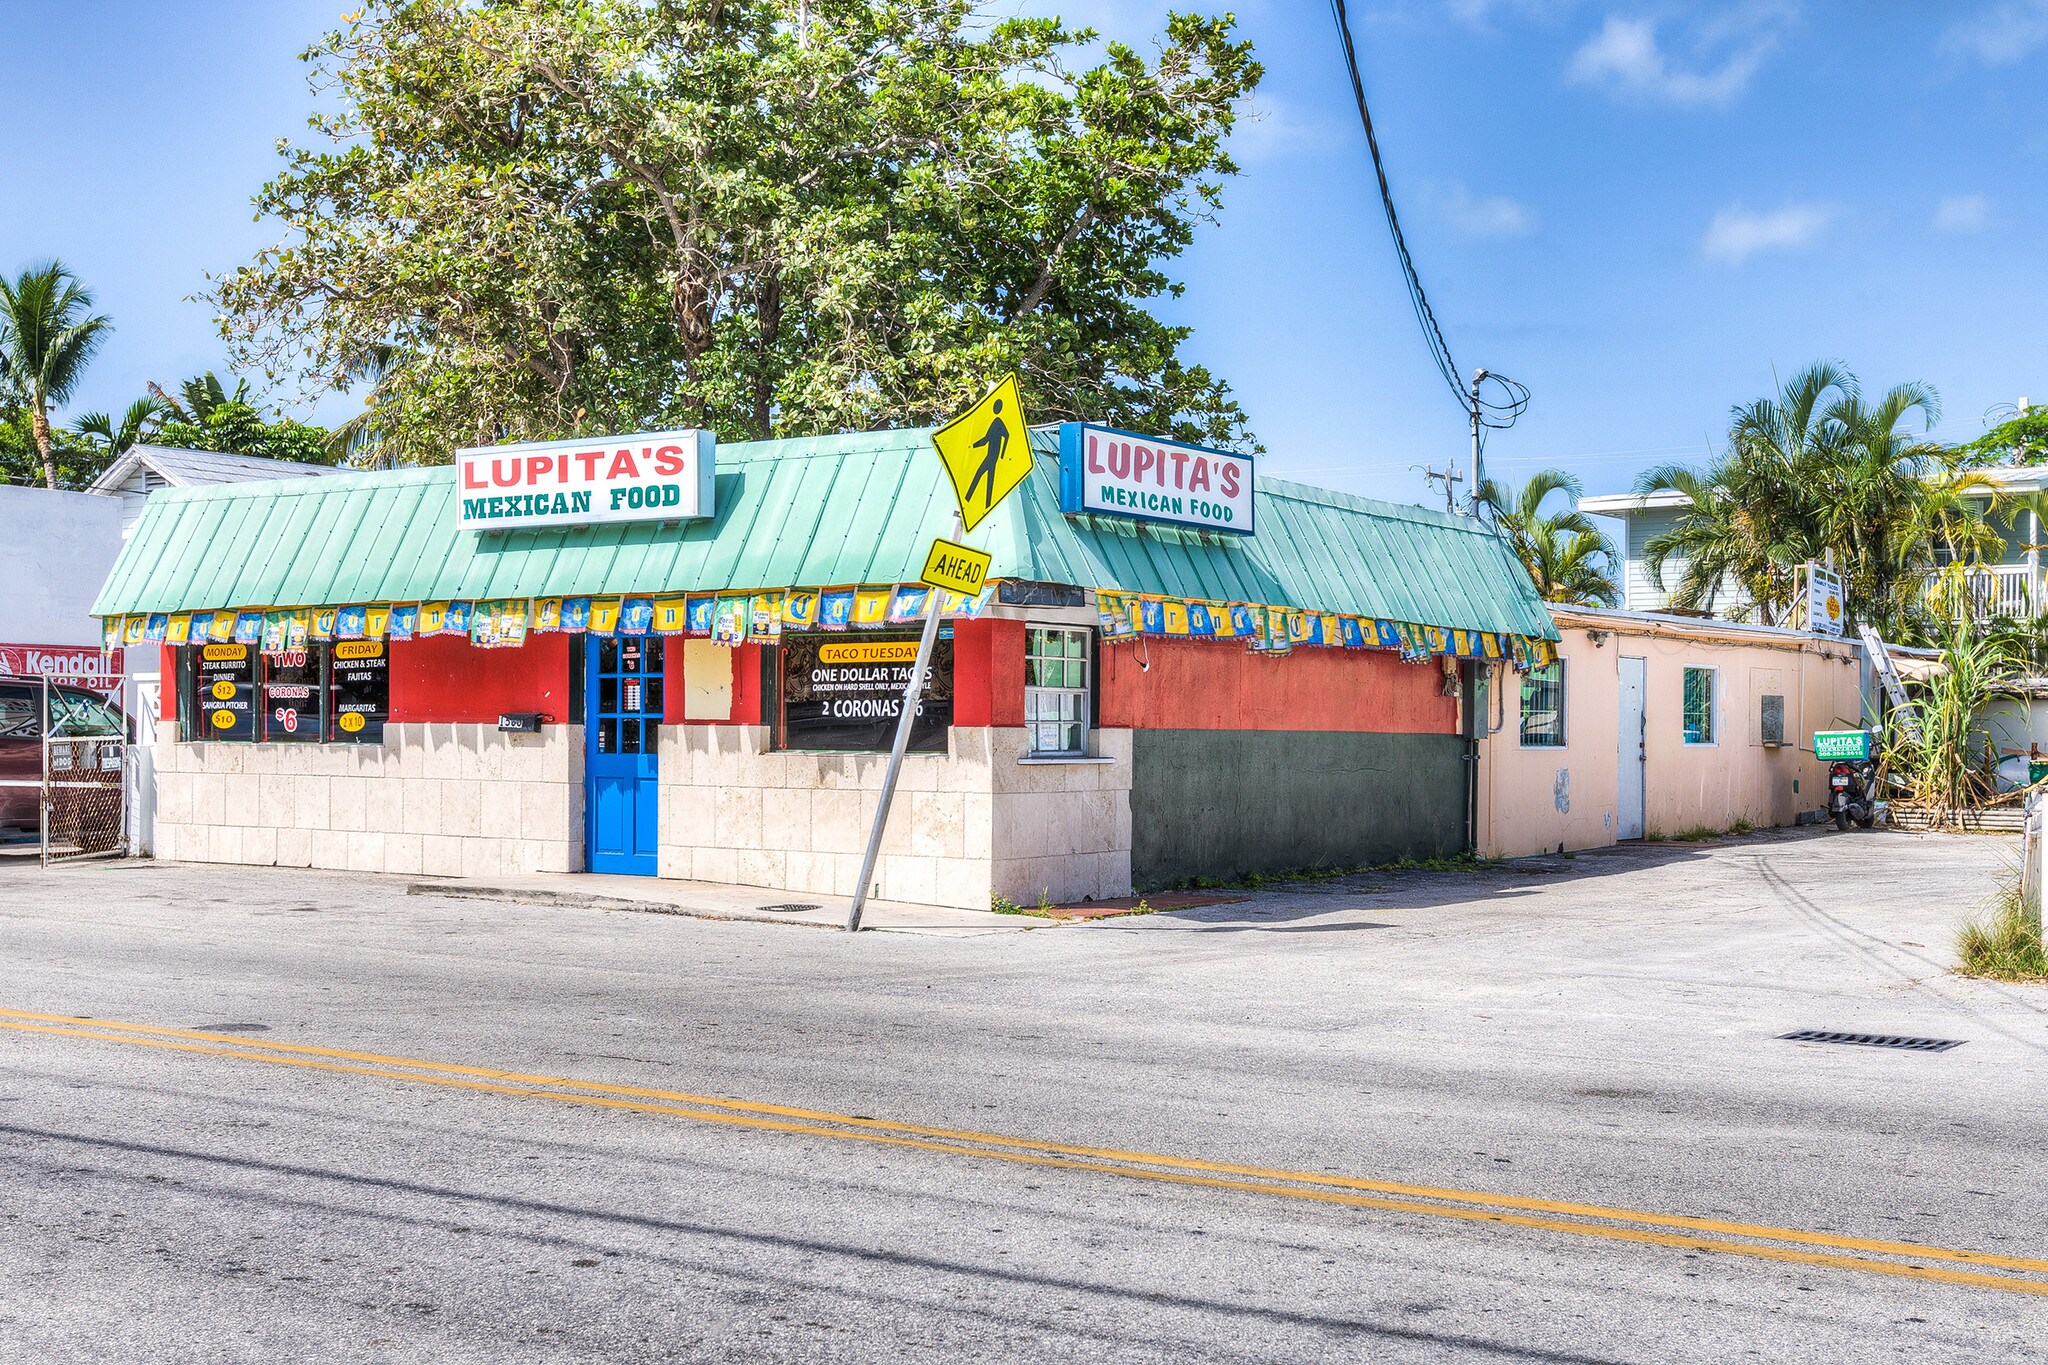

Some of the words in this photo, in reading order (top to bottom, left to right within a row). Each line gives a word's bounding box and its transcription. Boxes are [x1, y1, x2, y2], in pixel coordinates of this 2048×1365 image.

[464, 445, 685, 490] LUPITA'S
[1089, 435, 1240, 499] LUPITA'S
[463, 490, 592, 520] MEXICAN
[610, 484, 680, 511] FOOD
[1101, 485, 1183, 515] MEXICAN
[1190, 498, 1233, 523] FOOD
[933, 553, 981, 584] AHEAD
[206, 647, 243, 657] MONDAY
[341, 644, 378, 655] FRIDAY
[826, 648, 859, 660] TACO
[863, 647, 919, 659] TUESDAY
[26, 650, 111, 674] Kendall
[202, 661, 220, 670] STEAK
[220, 660, 246, 669] BURRITO
[273, 653, 306, 668] TWO
[333, 660, 359, 669] CHICKEN
[359, 659, 366, 668] &
[366, 658, 386, 668] STEAK
[213, 673, 235, 681] DINNER
[347, 673, 372, 681] FAJITAS
[811, 668, 837, 682] ONE
[840, 667, 888, 682] DOLLAR
[891, 666, 933, 681] TACS
[88, 677, 113, 688] OIL
[812, 683, 834, 691] CHICKEN
[834, 683, 843, 691] ON
[858, 682, 874, 690] SHELL
[874, 682, 891, 691] ONLY,
[891, 682, 911, 690] MEXICA
[217, 685, 231, 696] $12
[269, 686, 310, 699] CORONAS
[202, 701, 227, 710] SANGRIA
[226, 701, 248, 710] PITCHER
[338, 703, 376, 713] MARGARITAS
[822, 701, 830, 716] 2
[833, 699, 899, 718] CORONAS
[215, 715, 233, 724] $10
[275, 708, 298, 732] $6
[343, 716, 348, 727] 2
[354, 715, 362, 726] 10
[1817, 736, 1863, 747] LUPITA'S
